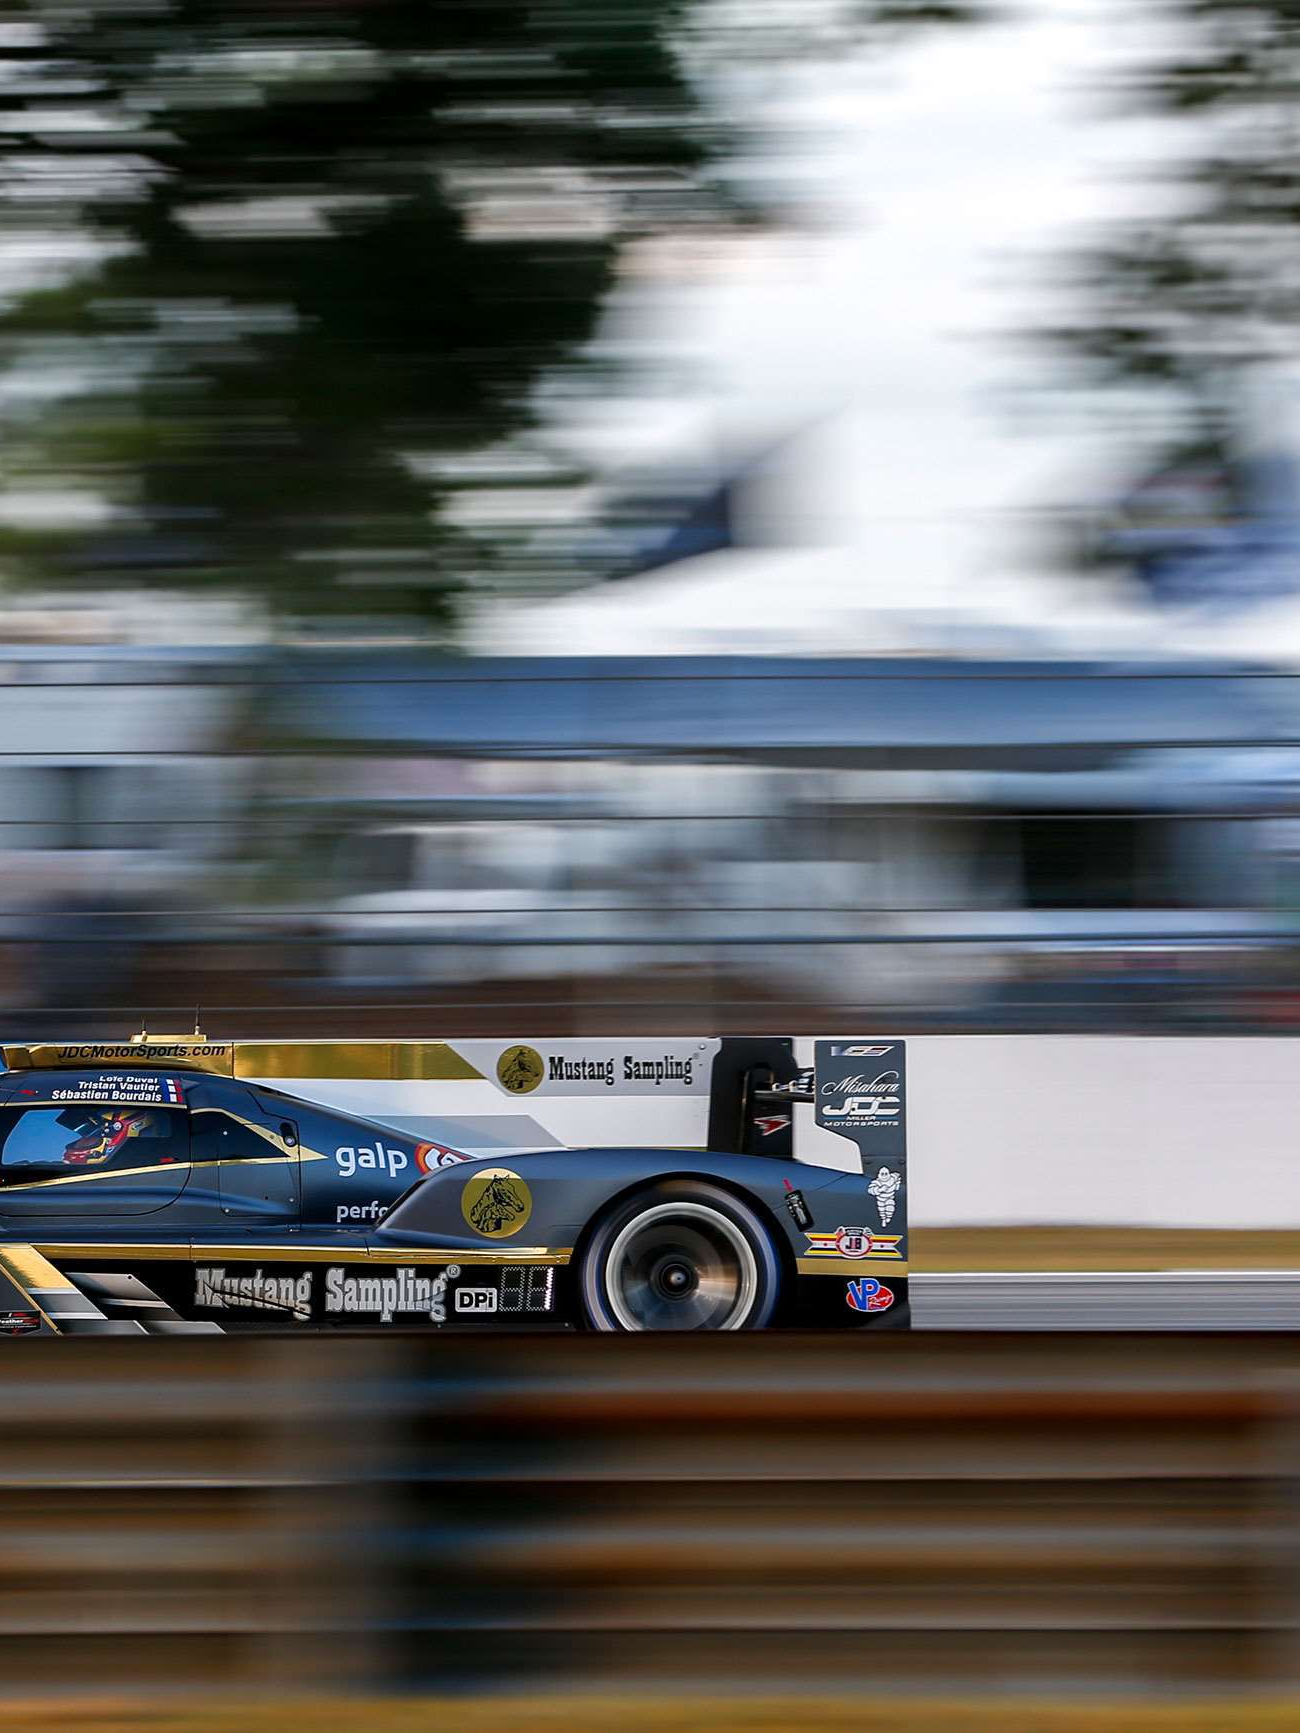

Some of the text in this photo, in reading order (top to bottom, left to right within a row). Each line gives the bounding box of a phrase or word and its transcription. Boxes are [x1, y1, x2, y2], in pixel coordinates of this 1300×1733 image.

[58, 1044, 225, 1059] JDCMotorSports.com
[126, 1076, 158, 1084] Duval
[548, 1056, 615, 1086] Mustang
[78, 1081, 160, 1092] Tristan Vautier
[821, 1070, 900, 1096] Misahara
[52, 1089, 162, 1102] Sébastien Bourdais
[821, 1096, 900, 1116] JDC
[335, 1142, 408, 1178] galp
[194, 1267, 314, 1322] Mustang
[459, 1291, 494, 1308] DPi
[846, 1277, 881, 1311] VP
